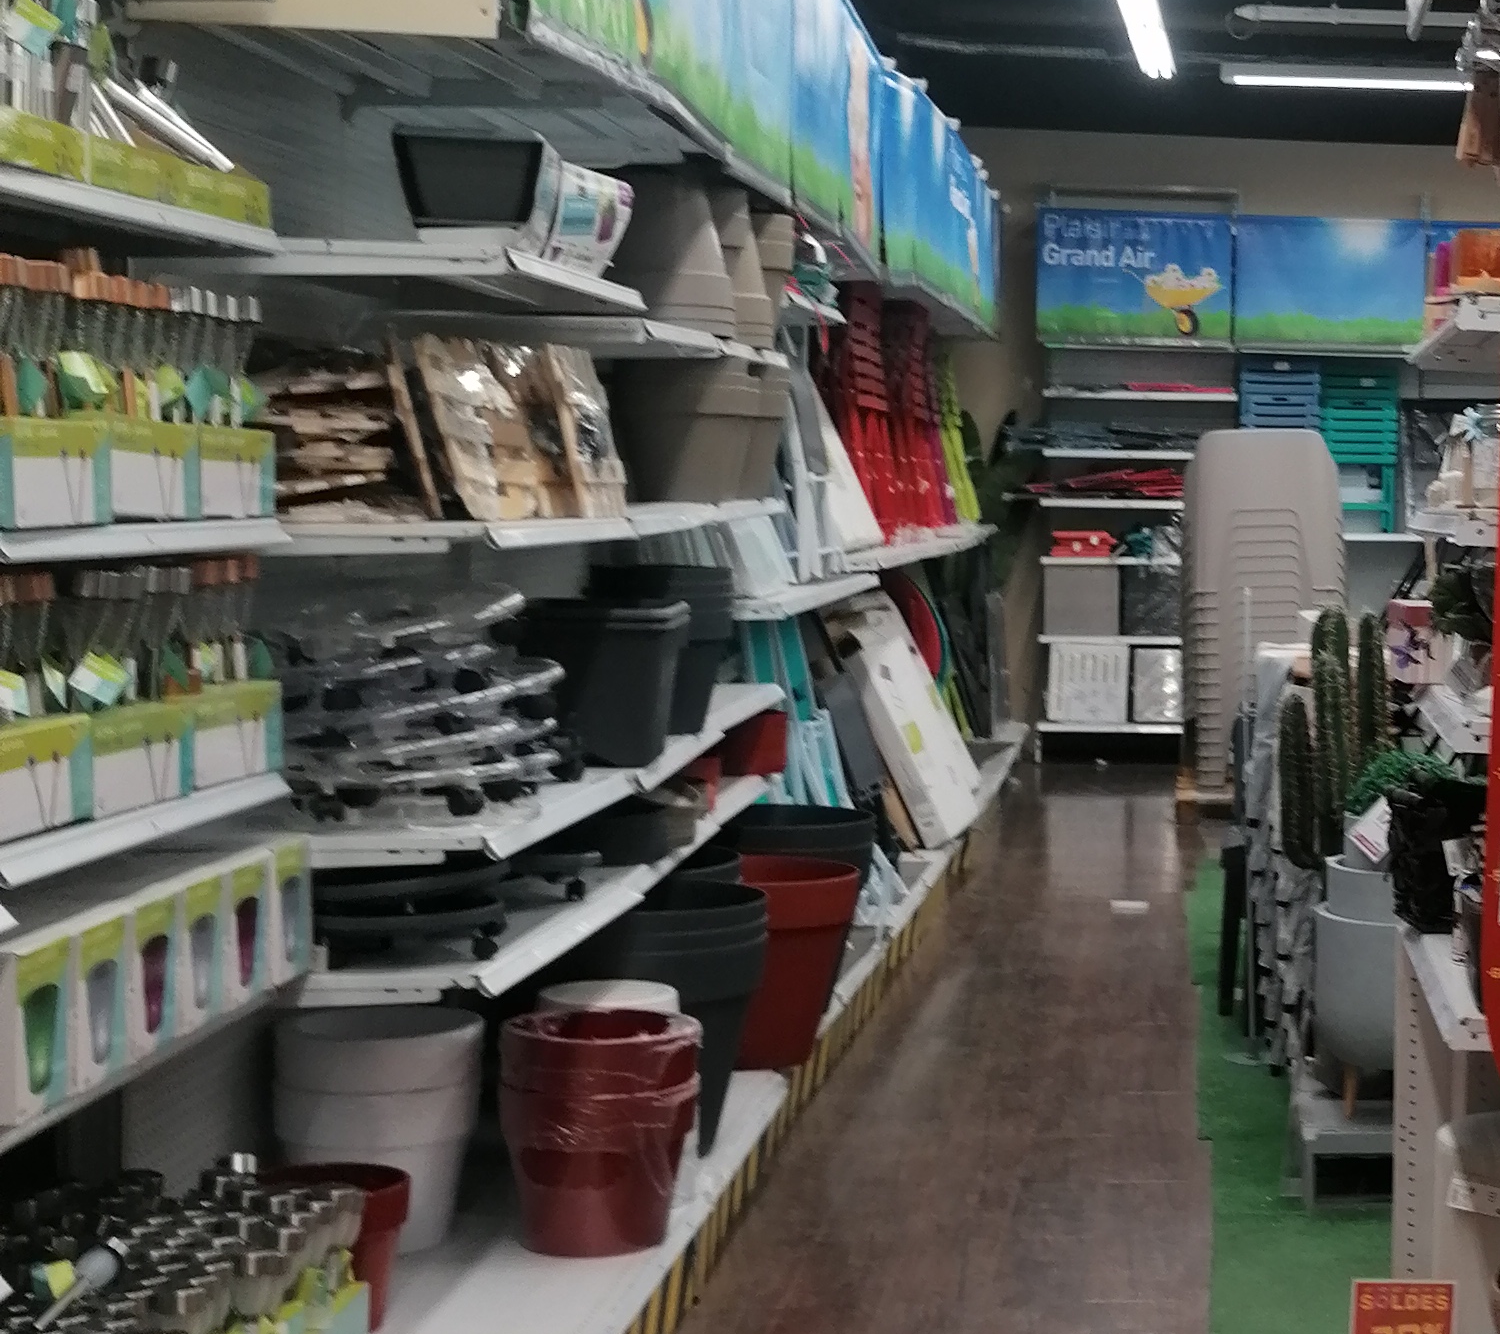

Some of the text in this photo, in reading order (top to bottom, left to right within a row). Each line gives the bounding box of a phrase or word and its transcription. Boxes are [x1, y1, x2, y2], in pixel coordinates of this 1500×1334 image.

[1042, 242, 1157, 269] Grand Air
[1359, 1293, 1449, 1312] SOLDES
